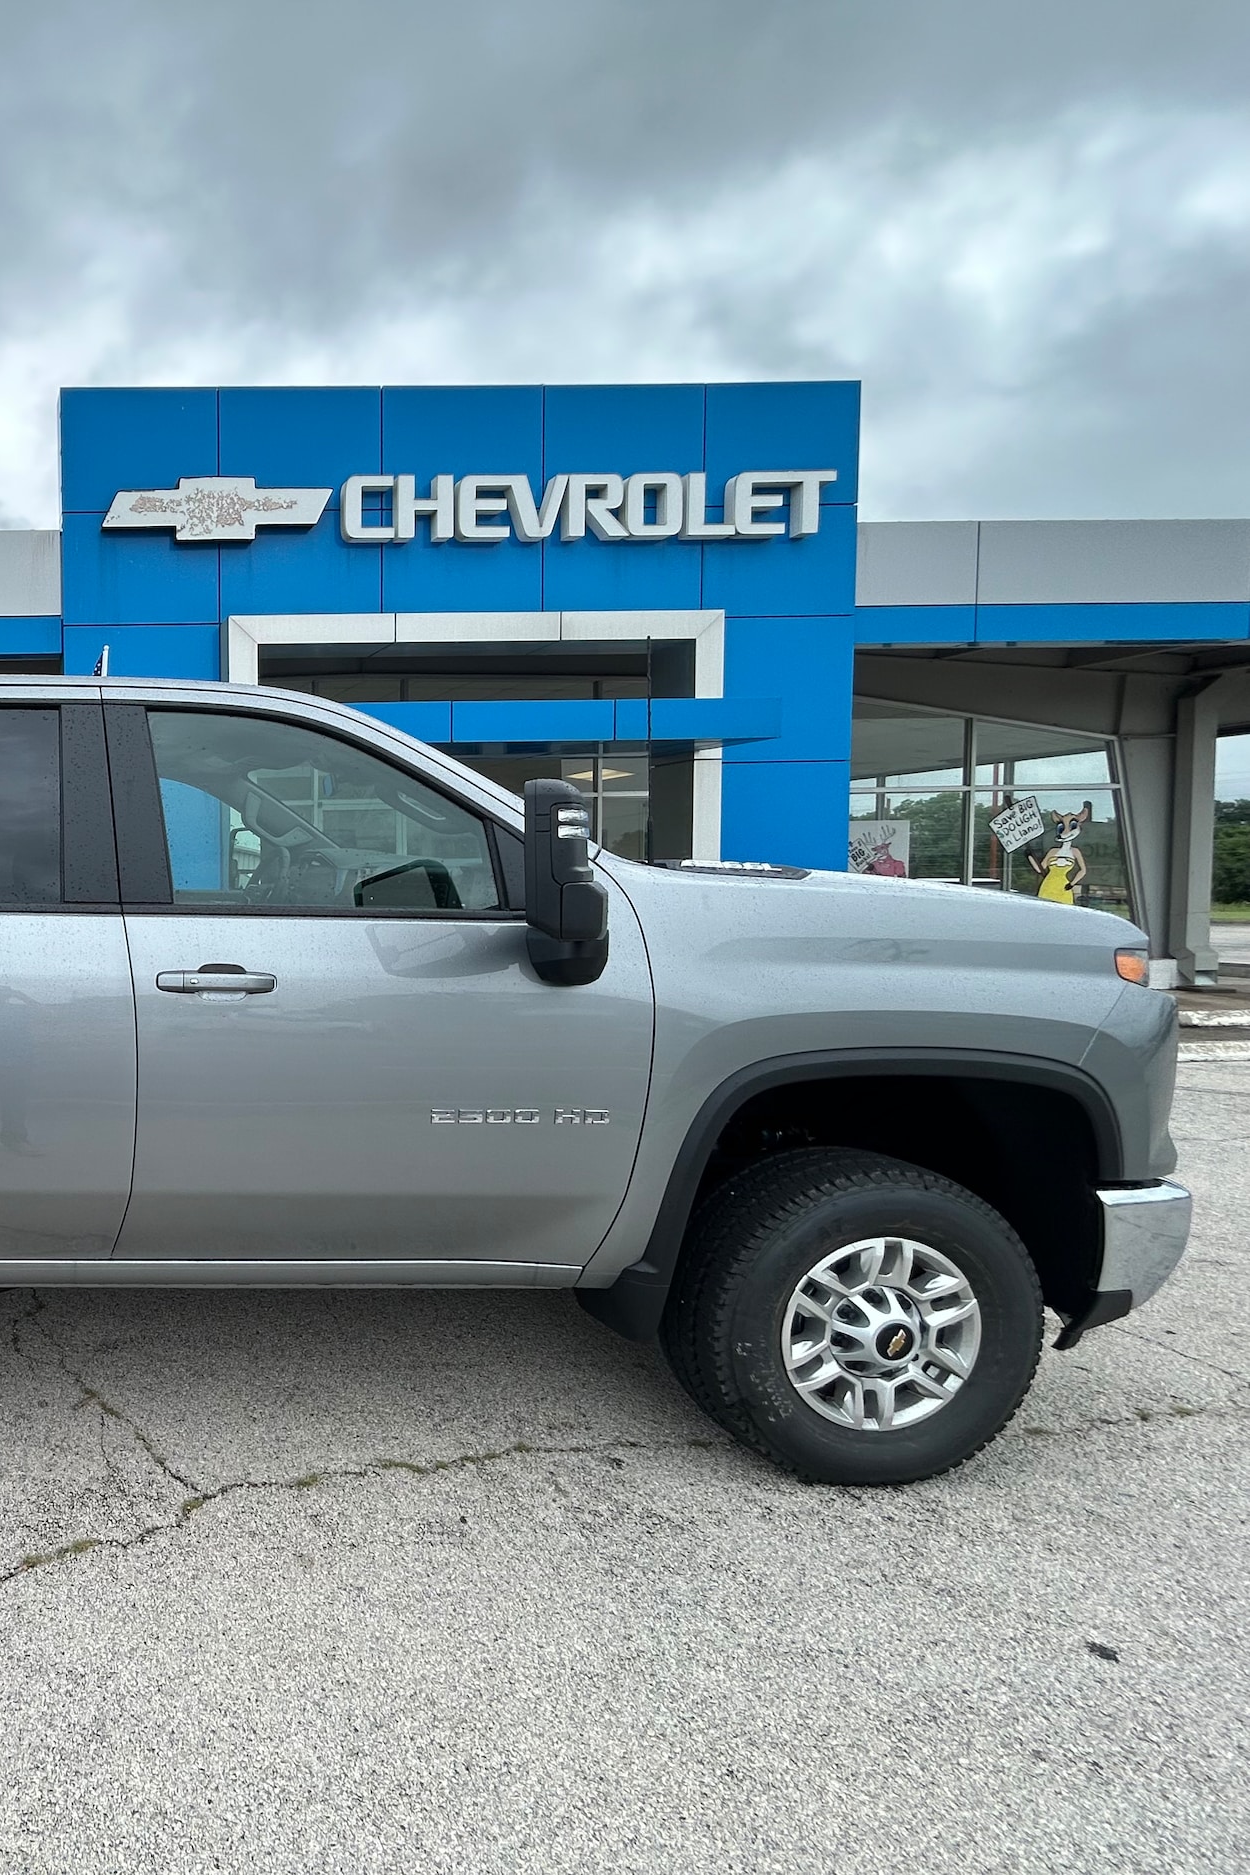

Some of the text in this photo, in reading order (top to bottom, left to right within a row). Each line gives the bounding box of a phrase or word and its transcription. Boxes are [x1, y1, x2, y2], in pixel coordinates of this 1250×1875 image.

[340, 469, 838, 543] CHEVROLET
[993, 800, 1034, 829] Save BIG
[1012, 818, 1043, 842] Llano!
[851, 848, 866, 862] BIG
[430, 1108, 610, 1124] 2500 HD
